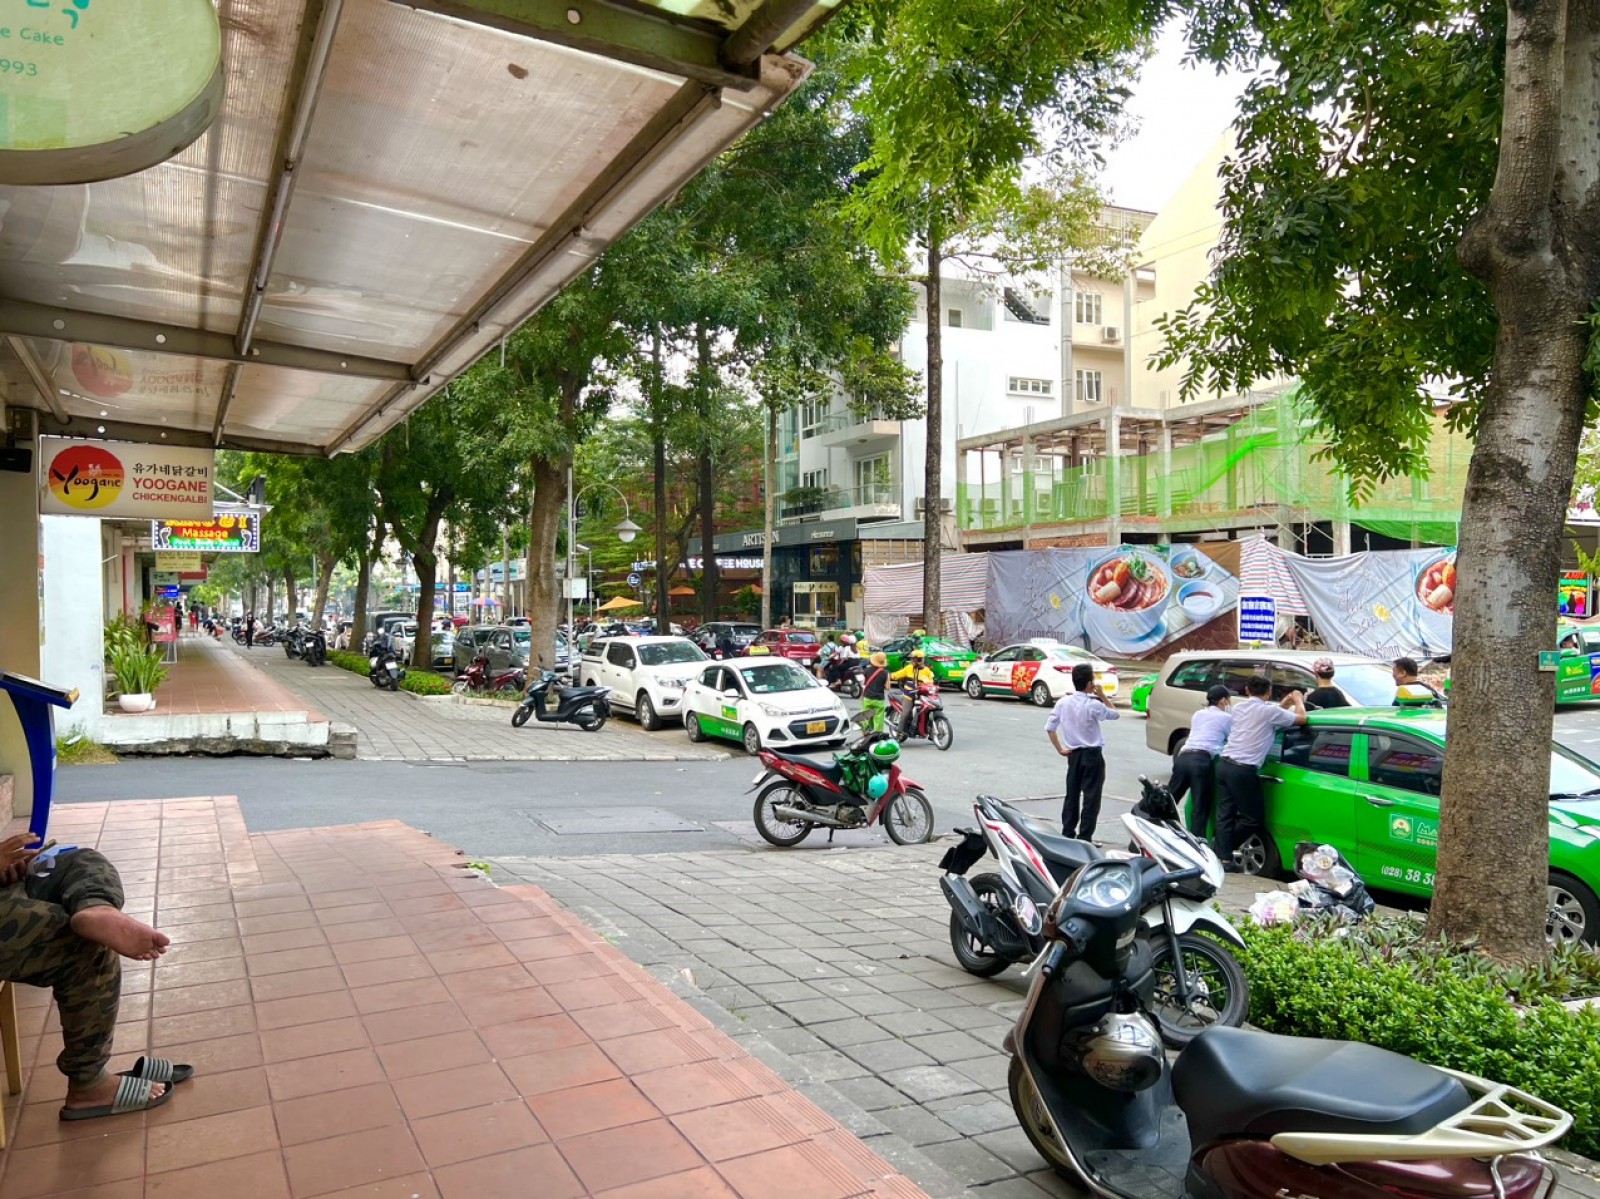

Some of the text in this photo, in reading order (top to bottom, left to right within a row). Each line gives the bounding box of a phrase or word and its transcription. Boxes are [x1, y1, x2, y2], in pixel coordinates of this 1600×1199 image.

[20, 27, 64, 46] Cake
[132, 462, 208, 478] 유가네닭갈비
[52, 464, 121, 501] Yoogane
[132, 476, 208, 493] YOOGANE
[132, 492, 208, 504] CHICKENGALBI
[182, 527, 229, 540] Massage
[742, 530, 780, 547] ARTISN
[1381, 865, 1402, 878] (028)
[1405, 868, 1421, 883] 38
